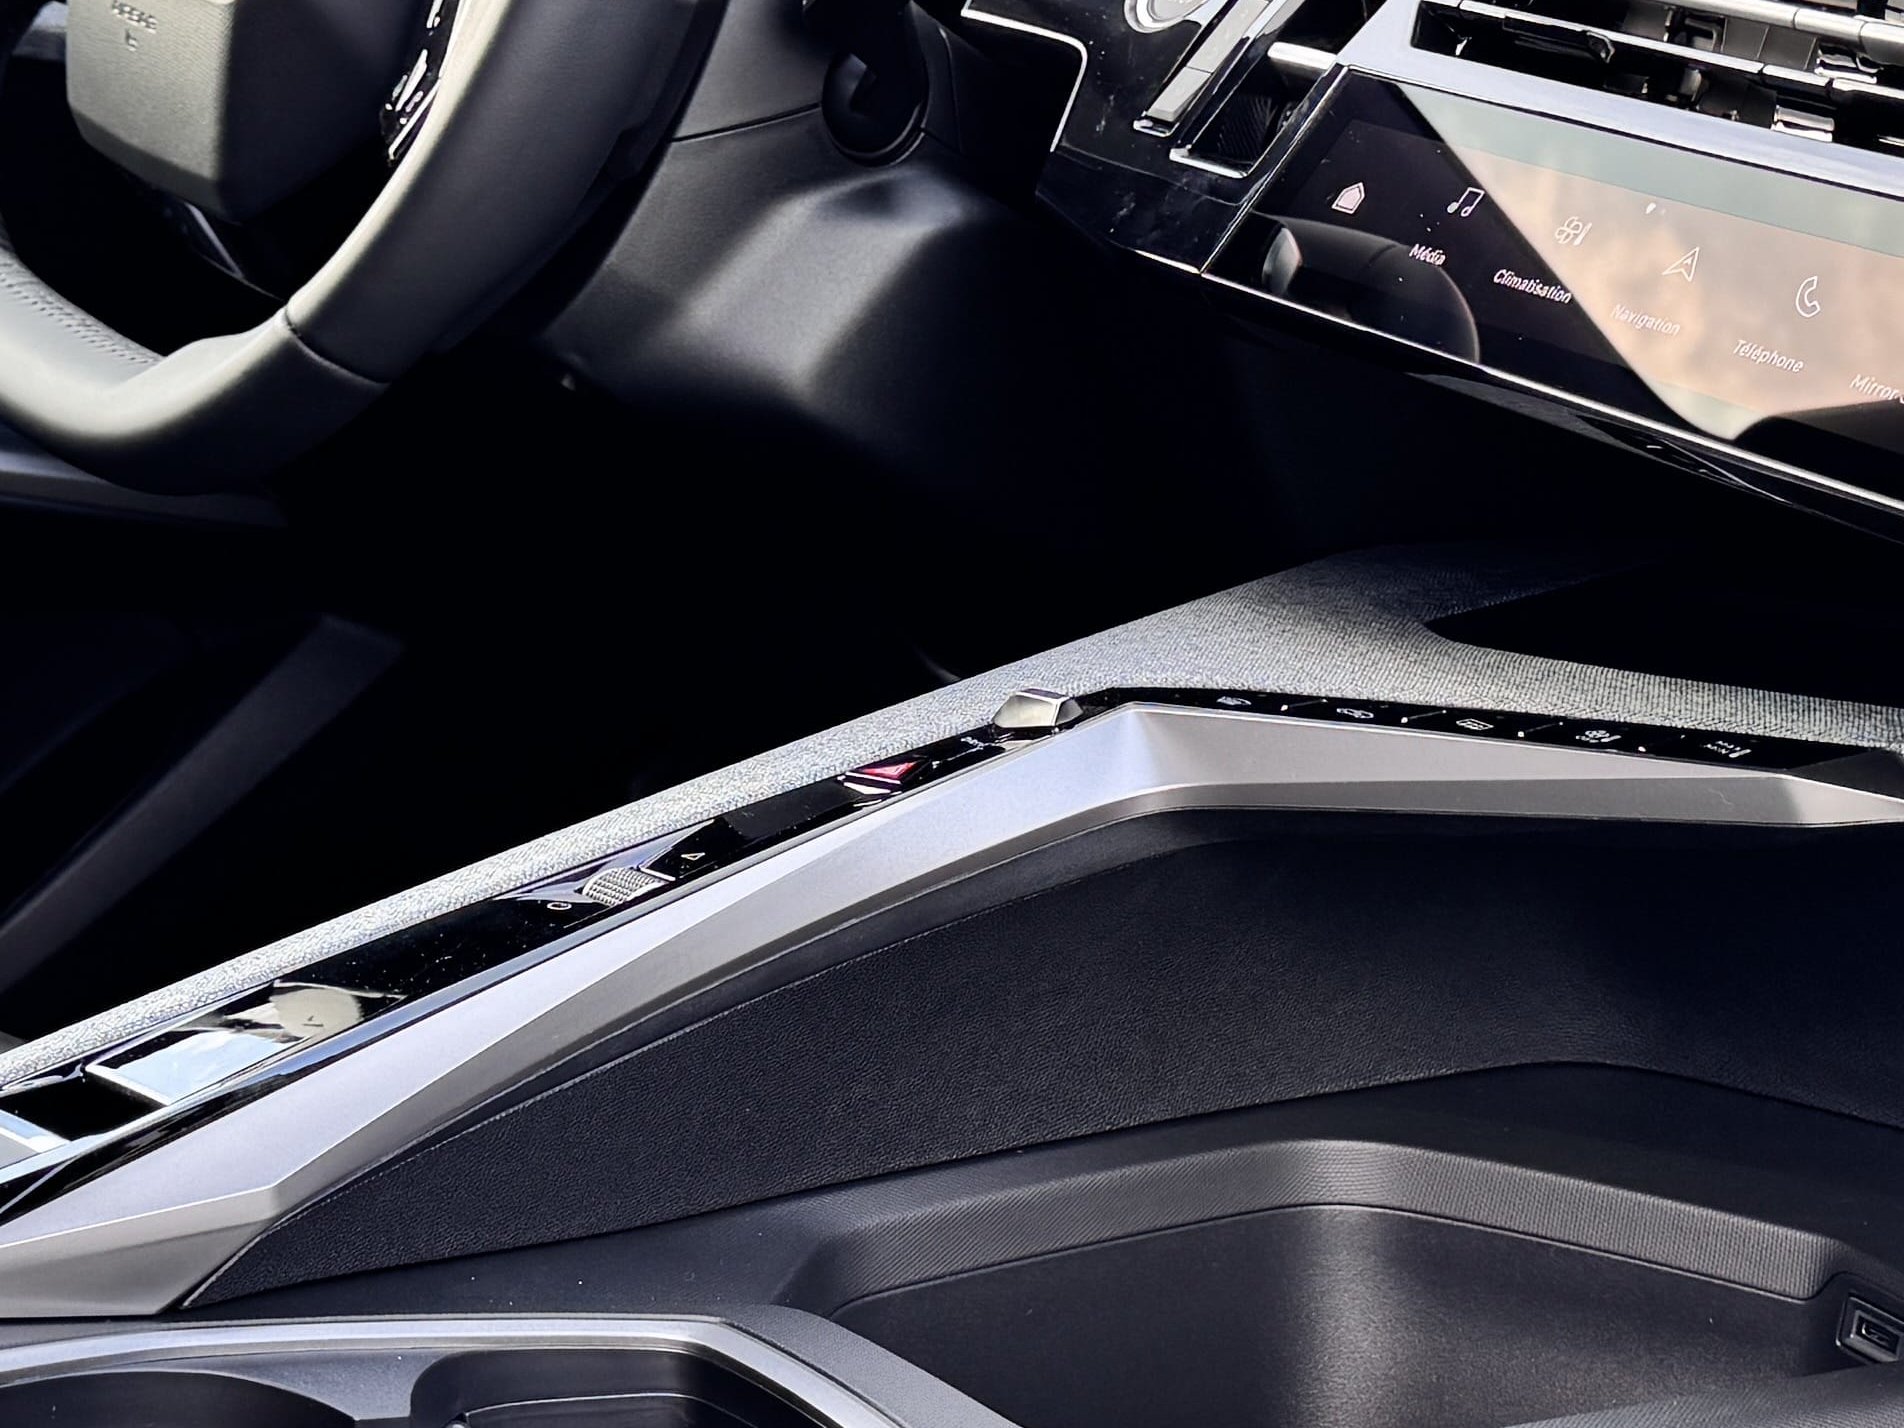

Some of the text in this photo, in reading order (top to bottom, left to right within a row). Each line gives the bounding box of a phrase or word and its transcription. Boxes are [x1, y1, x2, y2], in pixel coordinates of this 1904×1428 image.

[1493, 268, 1572, 305] Climatisation
[1610, 303, 1681, 336] Navigation
[1733, 338, 1805, 373] Téléphone
[1850, 373, 1898, 401] Mirror
